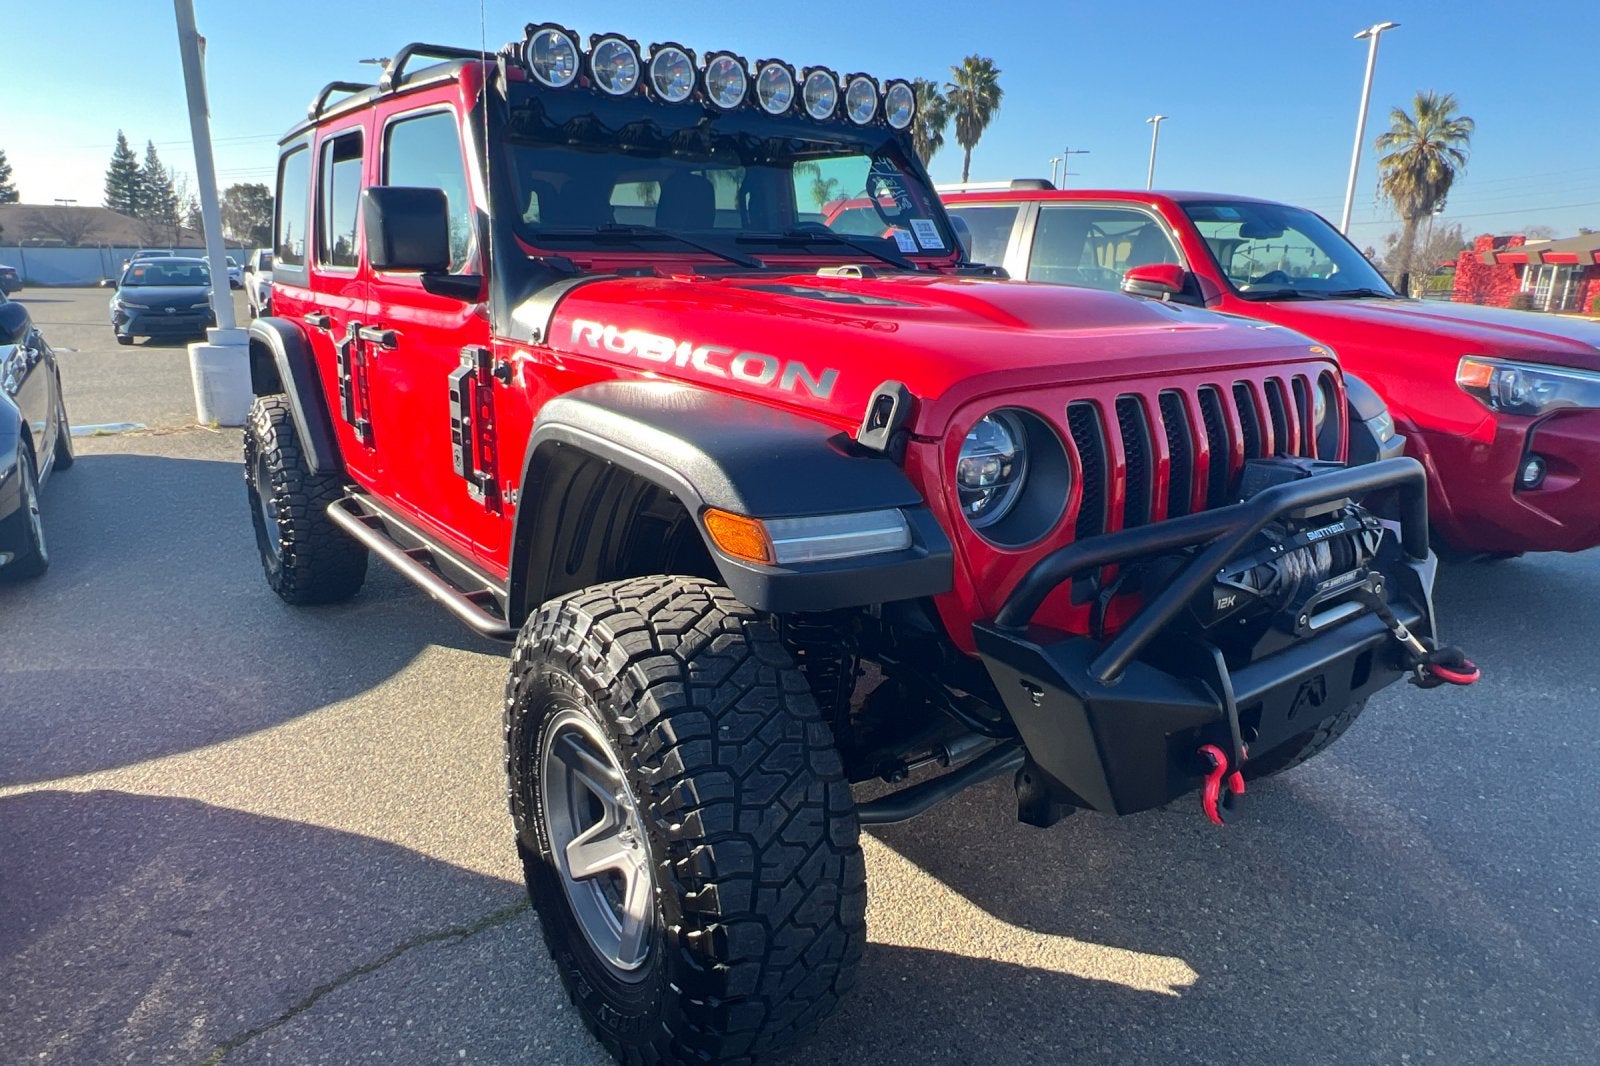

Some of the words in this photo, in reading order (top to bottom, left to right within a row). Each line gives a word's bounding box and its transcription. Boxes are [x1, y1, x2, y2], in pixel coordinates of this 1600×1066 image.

[571, 319, 840, 399] RUBICON
[1306, 522, 1346, 540] SMITTYBILT
[1217, 595, 1237, 610] 12K
